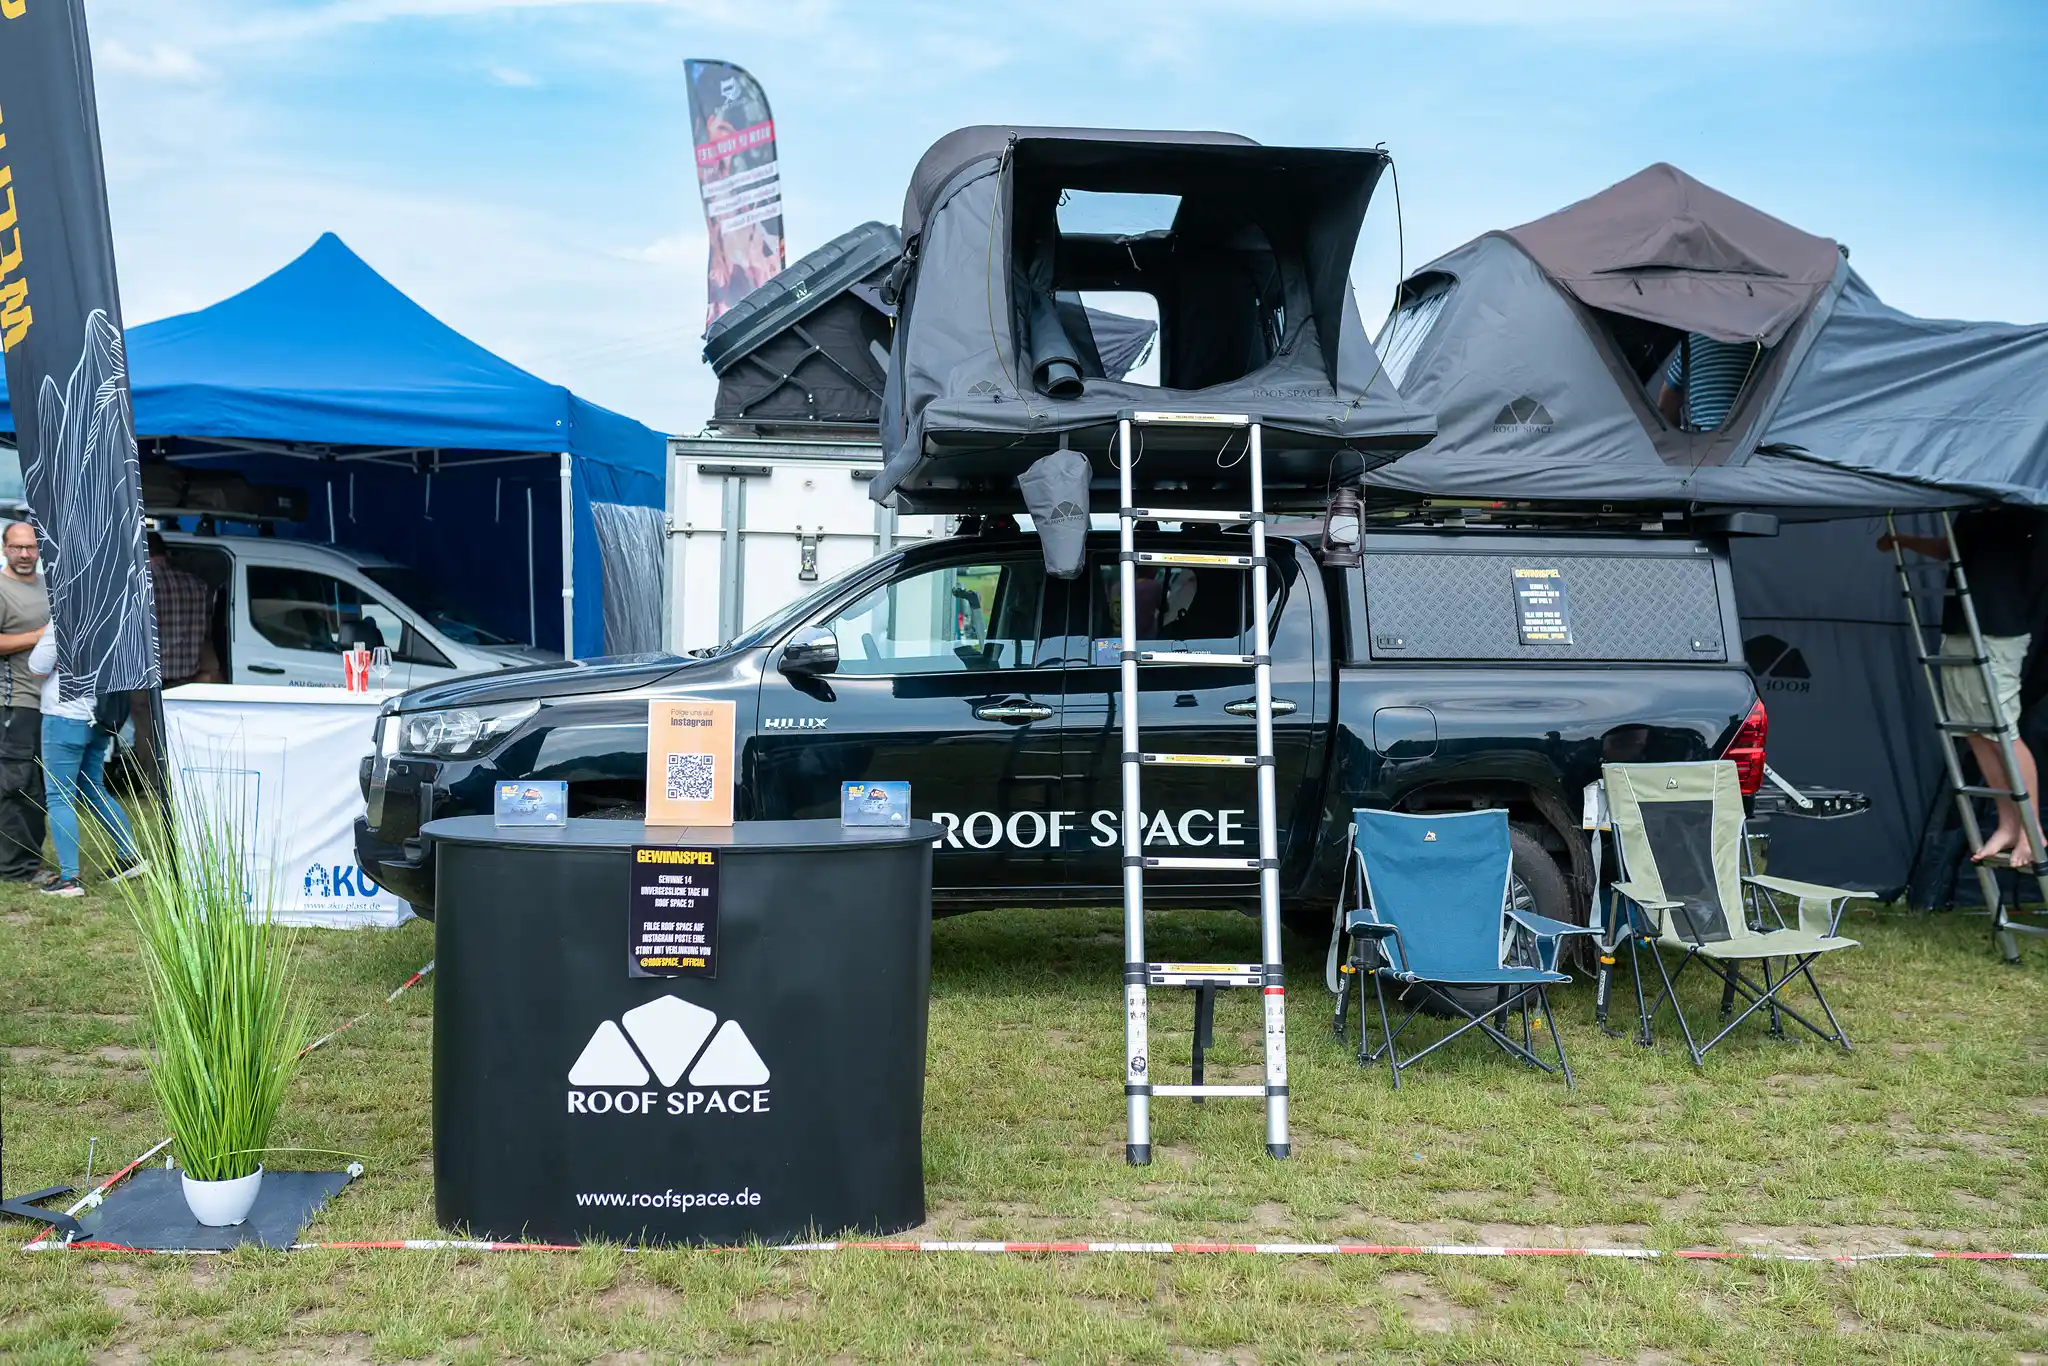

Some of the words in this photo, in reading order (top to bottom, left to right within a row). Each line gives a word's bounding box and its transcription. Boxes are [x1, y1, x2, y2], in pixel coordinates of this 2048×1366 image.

[1253, 389, 1284, 398] ROOF
[1287, 388, 1321, 398] SPACE
[670, 708, 689, 717] Folge
[670, 717, 713, 728] Instagram
[764, 718, 828, 729] HILUX
[932, 811, 1076, 848] ROOF
[636, 849, 714, 865] GEWINNSPIEL
[658, 874, 684, 884] GEWINNE
[684, 876, 692, 884] 14
[641, 886, 686, 896] UNVERGESSLICHE
[688, 888, 700, 896] TAGE
[701, 888, 708, 896] IM
[304, 902, 381, 912] www.aku-plast.de
[654, 898, 669, 907] ROOF
[670, 898, 687, 908] SPACE
[644, 922, 660, 931] FOLGE
[661, 922, 675, 931] ROOF
[676, 922, 692, 932] SPACE
[694, 922, 704, 932] AUF
[642, 934, 674, 942] INSTAGRAM
[674, 934, 692, 943] POSTE
[692, 934, 705, 944] EINE
[635, 946, 653, 955] STORY
[654, 946, 664, 954] MIT
[665, 946, 698, 955] VERLINKUNG
[700, 946, 712, 956] VON
[568, 1090, 658, 1114] ROOF
[666, 1089, 770, 1115] SPACE
[576, 1187, 761, 1213] www.roofspace.de
